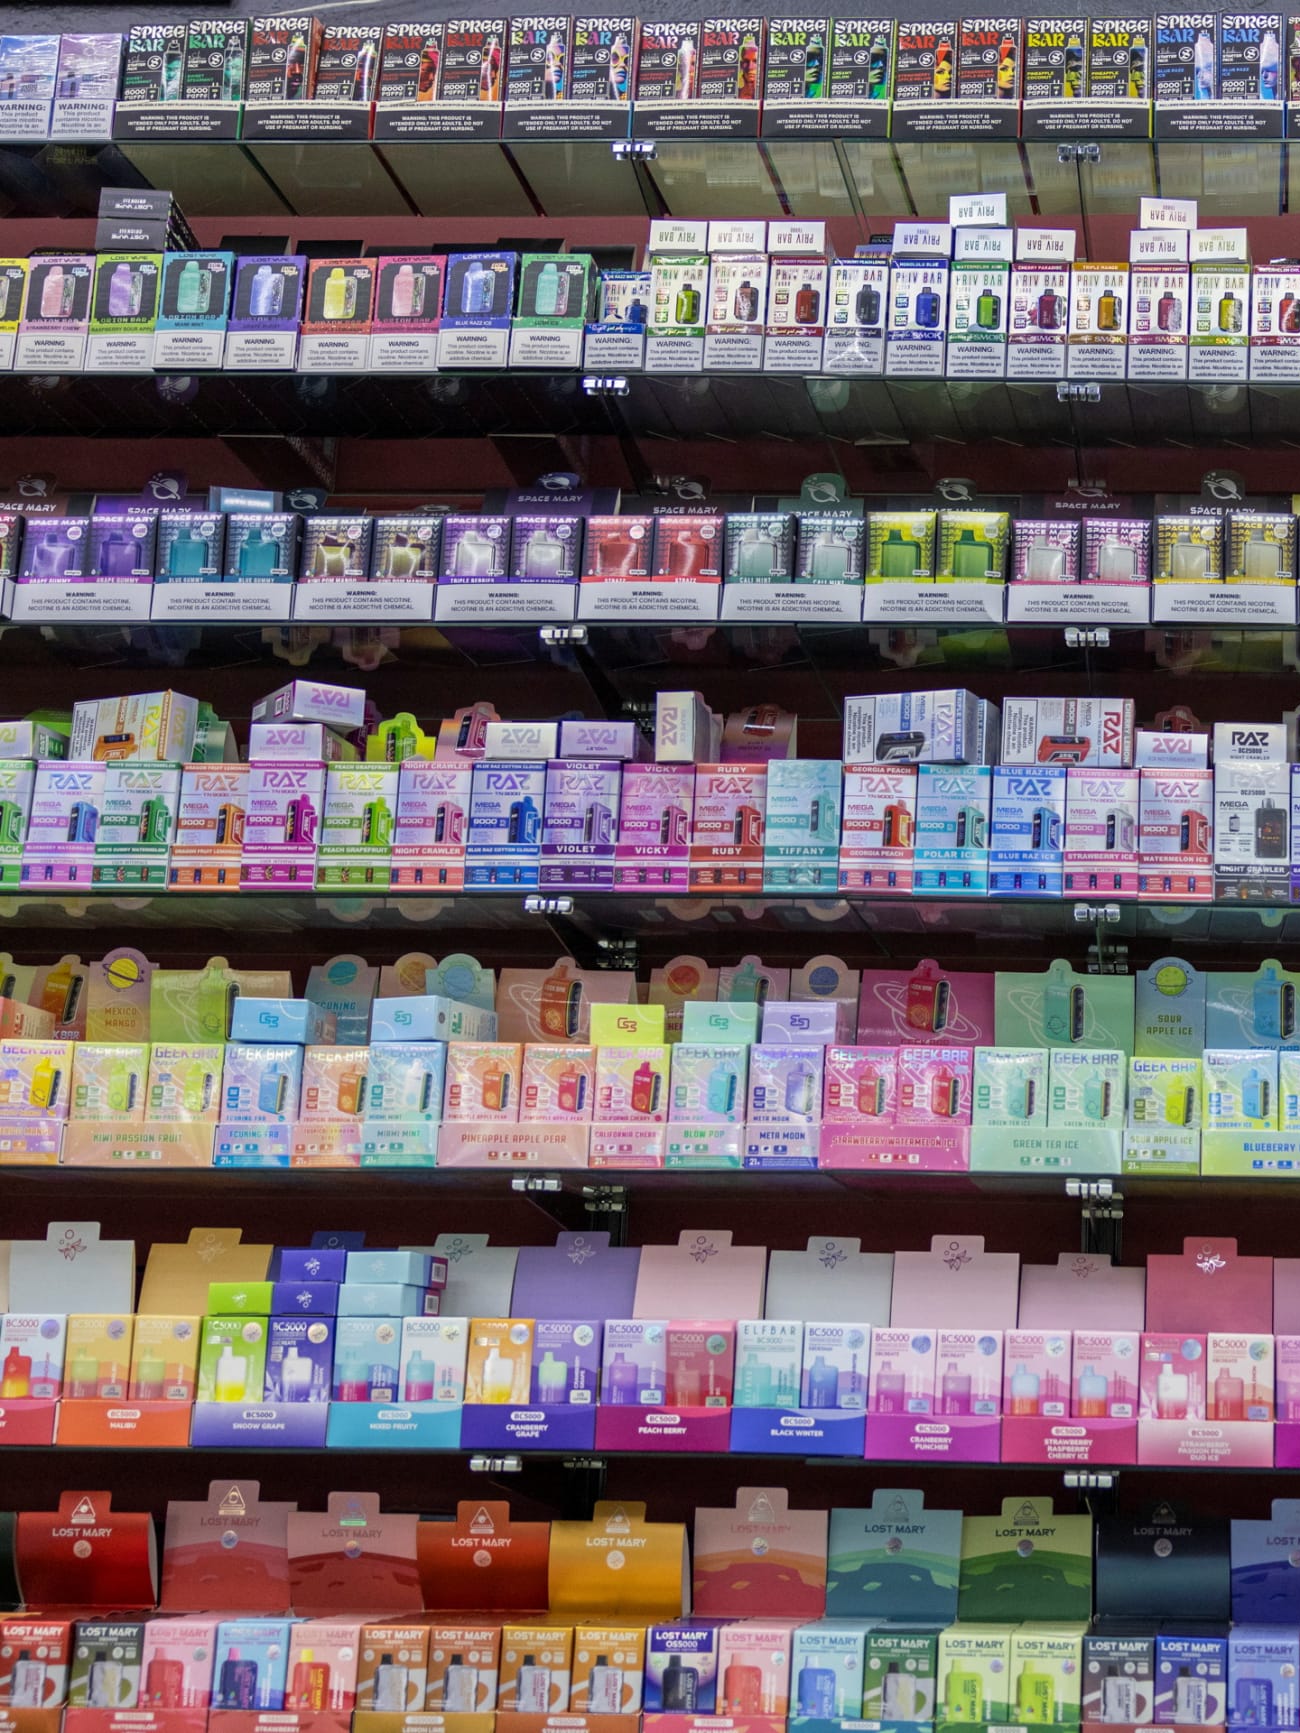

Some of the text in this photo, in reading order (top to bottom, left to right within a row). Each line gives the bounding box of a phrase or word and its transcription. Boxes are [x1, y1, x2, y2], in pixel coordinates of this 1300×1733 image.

[253, 17, 308, 32] SPREE
[511, 17, 566, 31] SPREE
[575, 18, 631, 31] SPREE
[1028, 21, 1084, 33] SPREE
[1157, 15, 1213, 29] SPREE
[129, 25, 185, 40] SPREE
[189, 20, 245, 35] SPREE
[511, 31, 547, 45] BAR
[576, 32, 612, 46] BAR
[1028, 34, 1064, 47] BAR
[1156, 29, 1194, 42] BAR
[189, 34, 226, 49] BAR
[923, 273, 942, 284] BAR
[1045, 275, 1064, 286] BAR
[1108, 275, 1123, 286] BAR
[912, 331, 941, 340] SMOK
[517, 495, 583, 503] SPACE MARY
[653, 506, 718, 515] SPACE MARY
[1232, 731, 1269, 747] RAZ
[118, 771, 162, 788] RAZ
[263, 771, 307, 788] RAZ
[486, 773, 531, 790] RAZ
[474, 818, 498, 826] 9000
[556, 845, 596, 854] VIOLET
[635, 847, 669, 855] VICKY
[712, 847, 742, 855] RUBY
[923, 850, 977, 858] POLAR ICE
[998, 852, 1056, 861] BLUE RAZ ICE
[1219, 866, 1285, 874] NIGHT CRAWLER
[105, 1007, 136, 1016] MEXICO
[105, 1019, 136, 1028] MANGO
[1157, 1014, 1182, 1024] SOUR
[1146, 1026, 1192, 1036] APPLE ICE
[1054, 1053, 1119, 1066] GEEK BAR
[92, 1133, 183, 1143] KIWI PASSION FRUIT
[461, 1135, 566, 1144] PINEAPPLE APPLE PEAR
[759, 1132, 806, 1140] META MOON
[1013, 1140, 1079, 1149] GREEN TEA ICE
[1243, 1142, 1295, 1152] BLUEBERRY
[744, 1325, 796, 1337] ELFBAR
[808, 1327, 844, 1337] BC5000
[663, 1427, 687, 1435] BERRY
[770, 1429, 823, 1438] BLACK WINTER
[910, 1437, 953, 1445] CRANBERRY
[915, 1443, 949, 1451] PUNCHER
[52, 1528, 112, 1537] LOST MARY
[995, 1528, 1056, 1538] LOST MARY
[586, 1538, 647, 1547] LOST MARY
